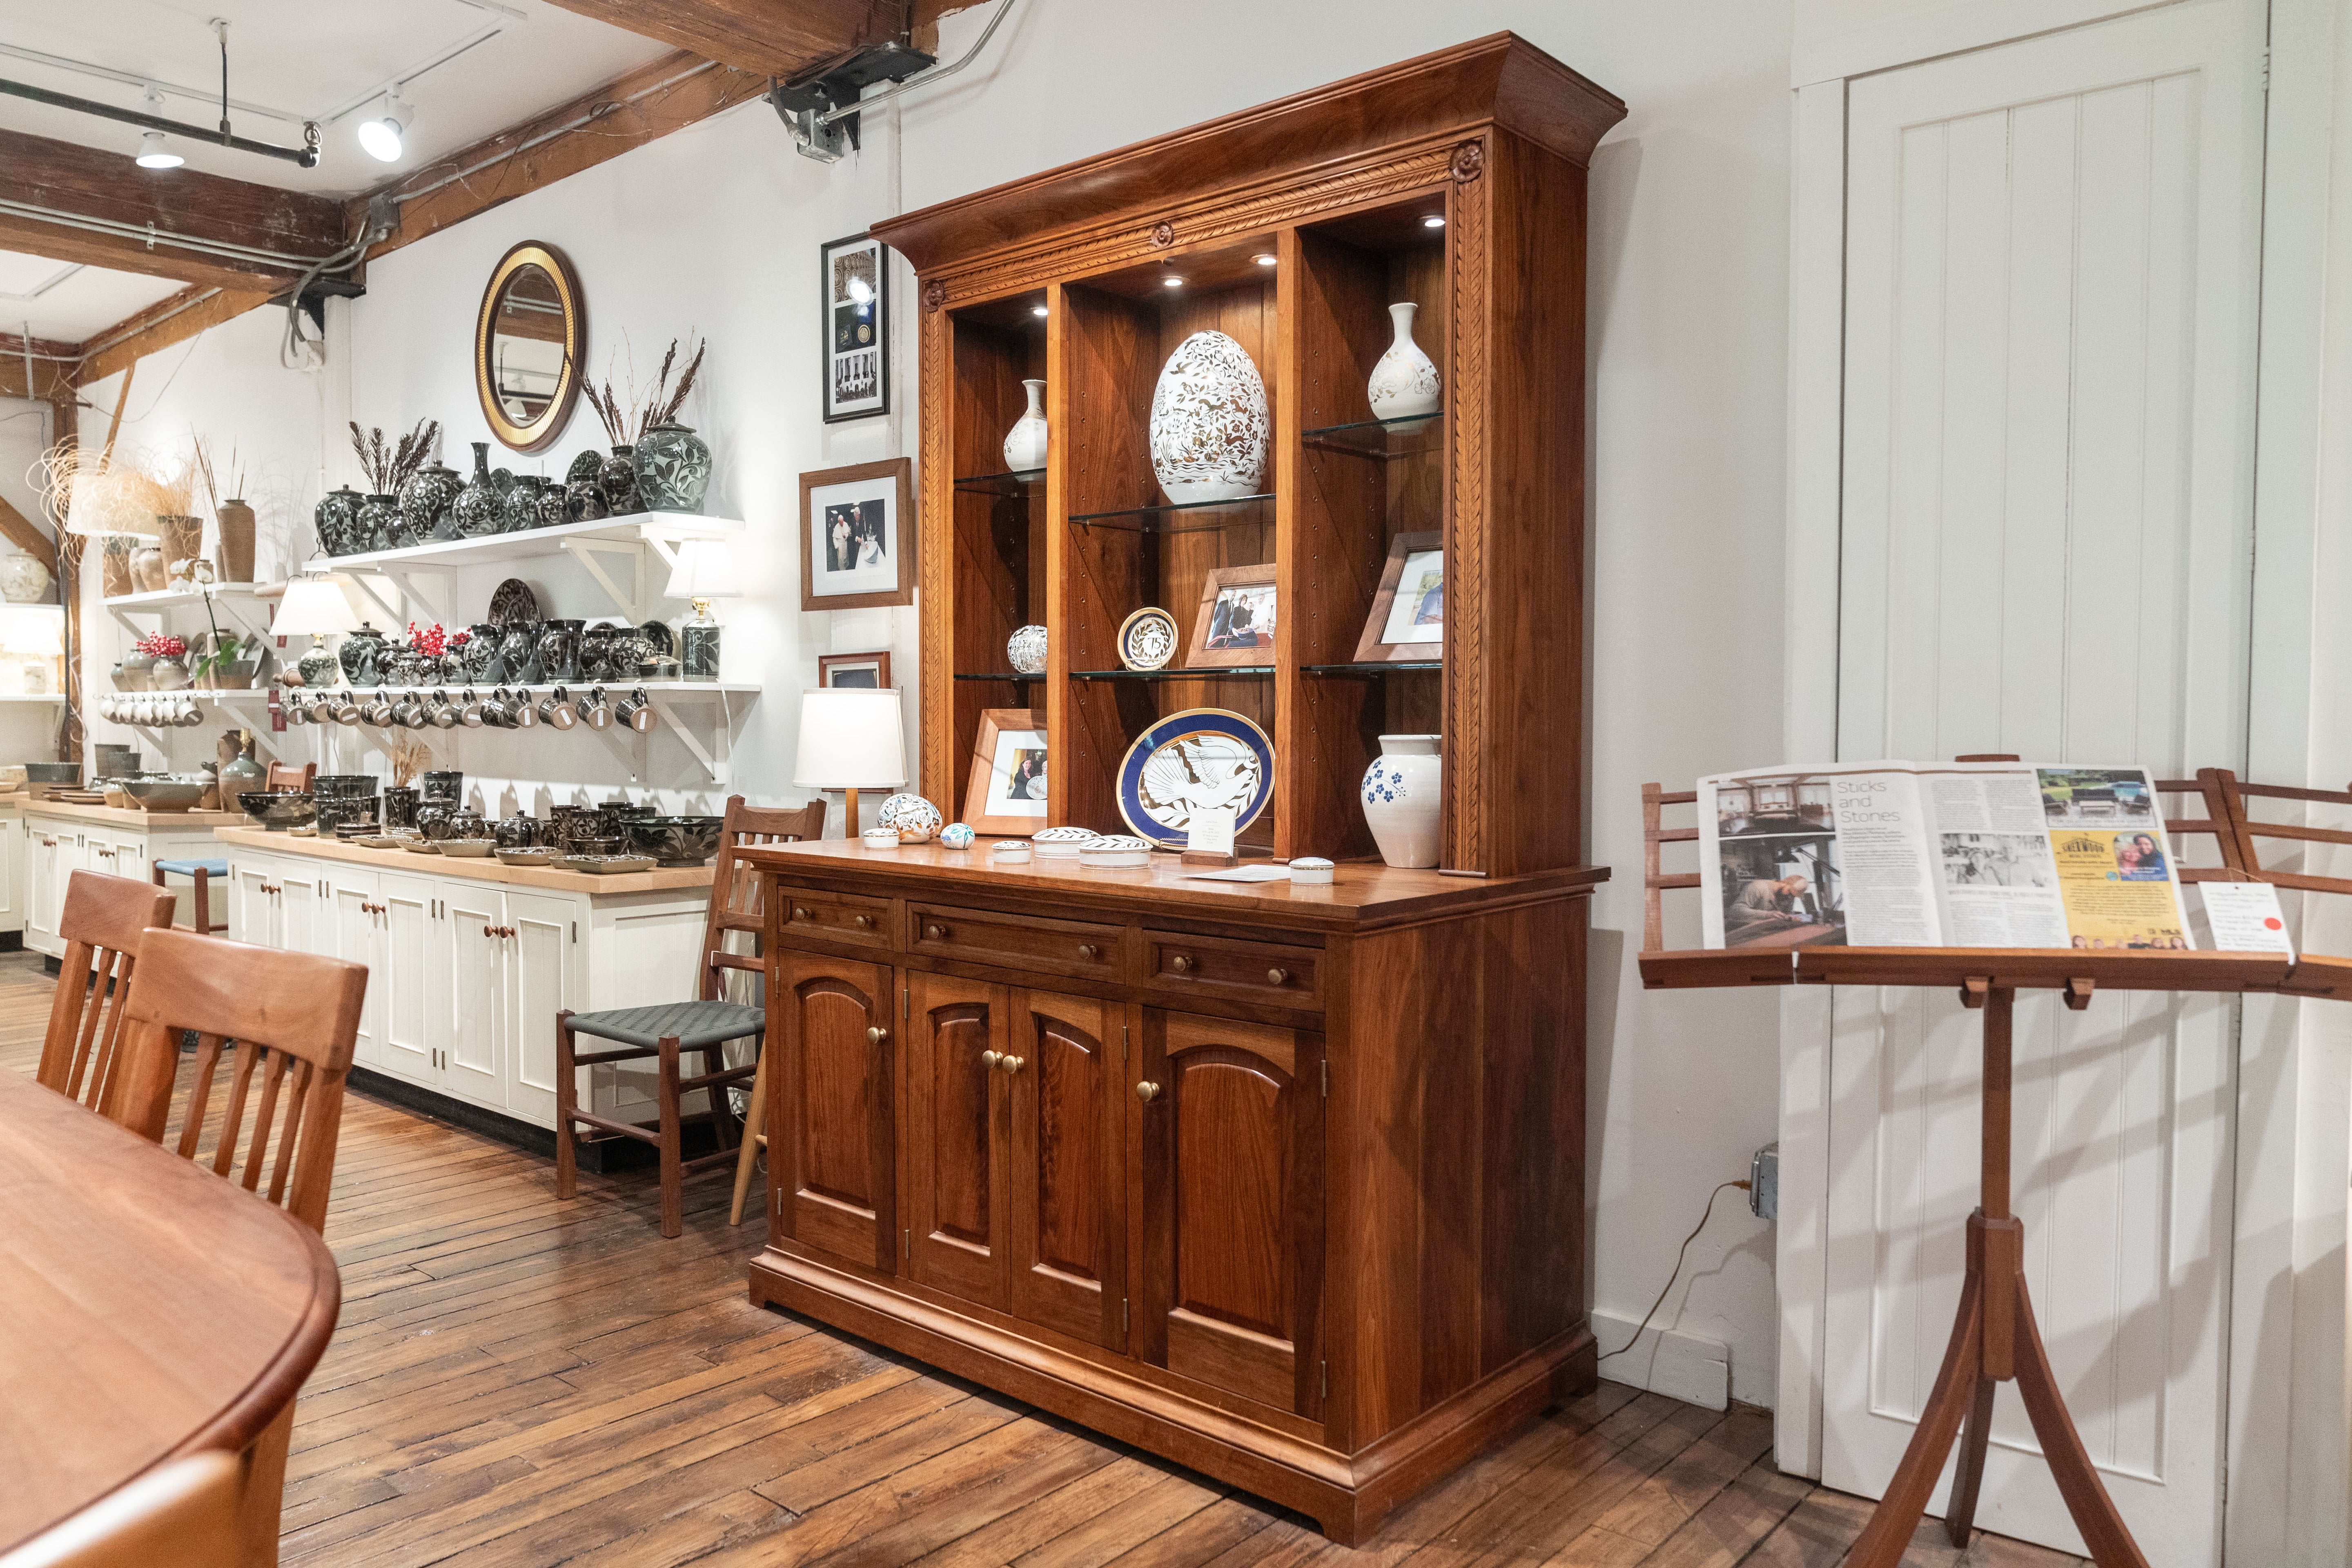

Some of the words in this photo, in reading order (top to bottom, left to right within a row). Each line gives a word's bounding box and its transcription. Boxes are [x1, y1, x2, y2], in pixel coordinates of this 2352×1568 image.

[1148, 637, 1161, 650] 75
[1838, 780, 1887, 793] Sticks
[1839, 795, 1872, 808] and
[1841, 811, 1901, 823] Stones
